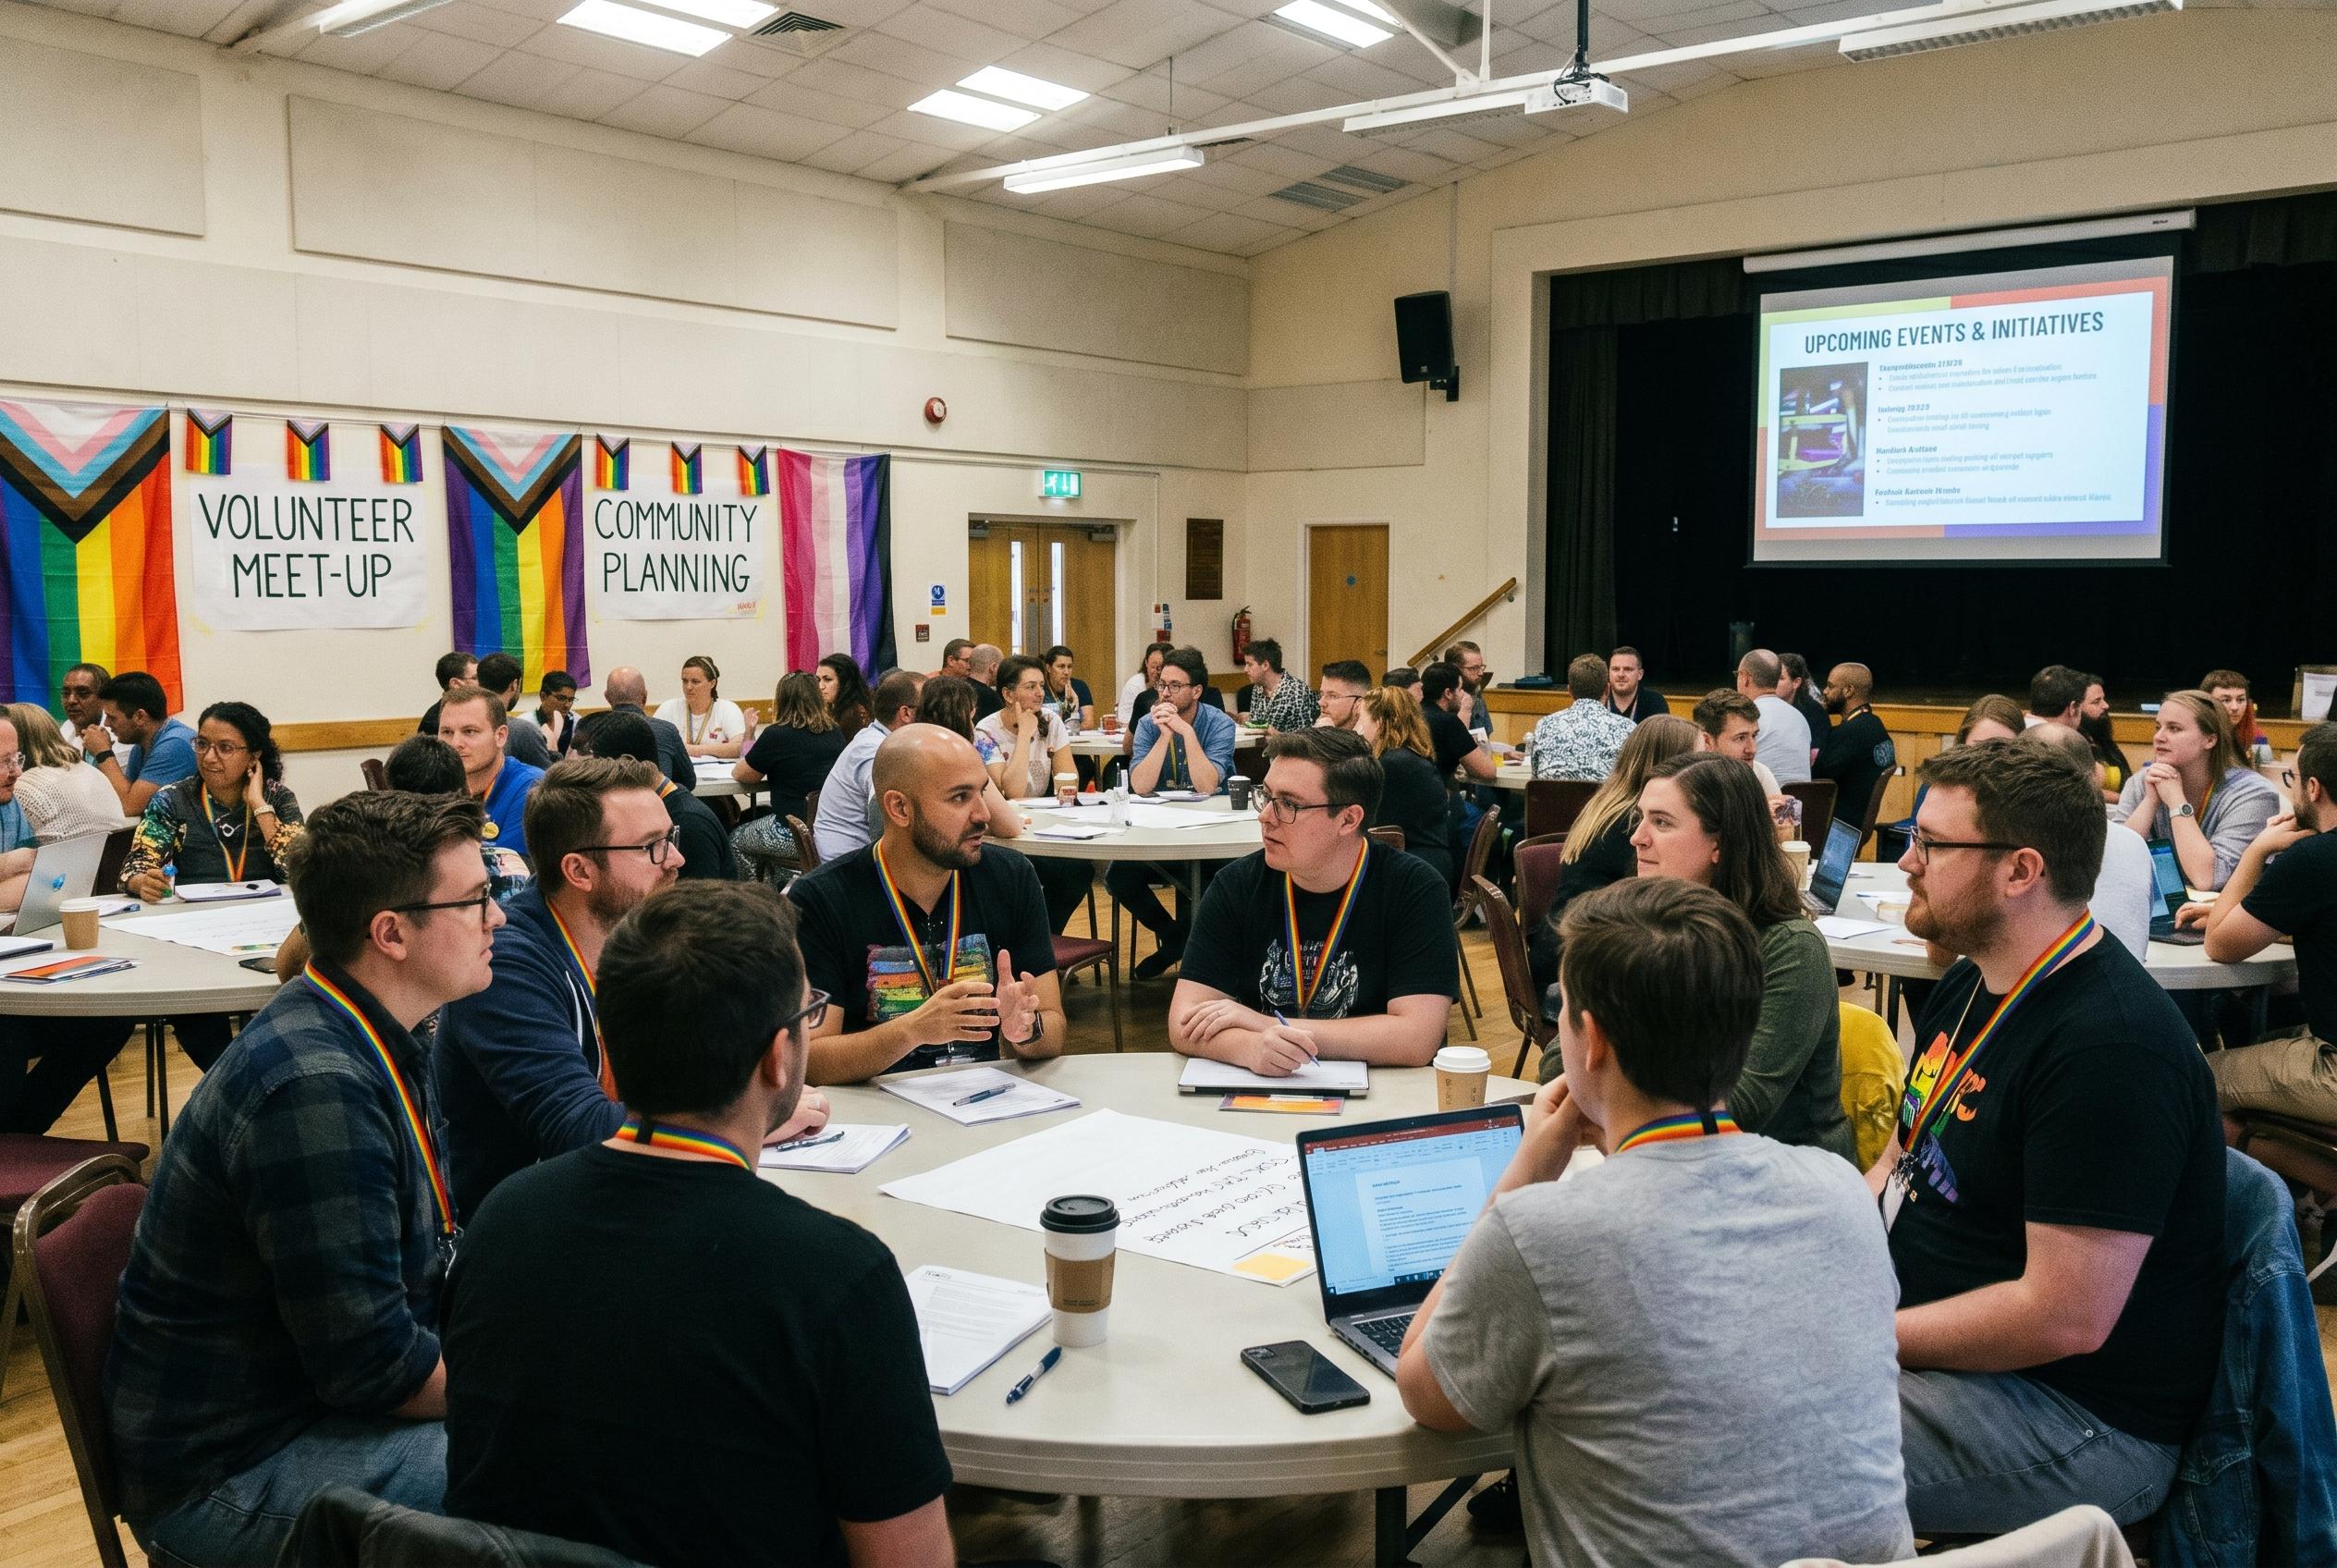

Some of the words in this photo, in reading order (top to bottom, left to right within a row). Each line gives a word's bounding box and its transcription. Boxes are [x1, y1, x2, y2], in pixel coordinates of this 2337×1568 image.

[1805, 329, 1891, 354] UPCOMING
[1898, 324, 1966, 347] EVENTS
[1972, 321, 1986, 341] &
[1992, 311, 2104, 339] INITIATIVES
[199, 494, 414, 543] VOLUNTEER
[594, 497, 758, 543] COMMUNITY
[233, 553, 392, 598] MEET-UP
[604, 552, 751, 593] PLANNING
